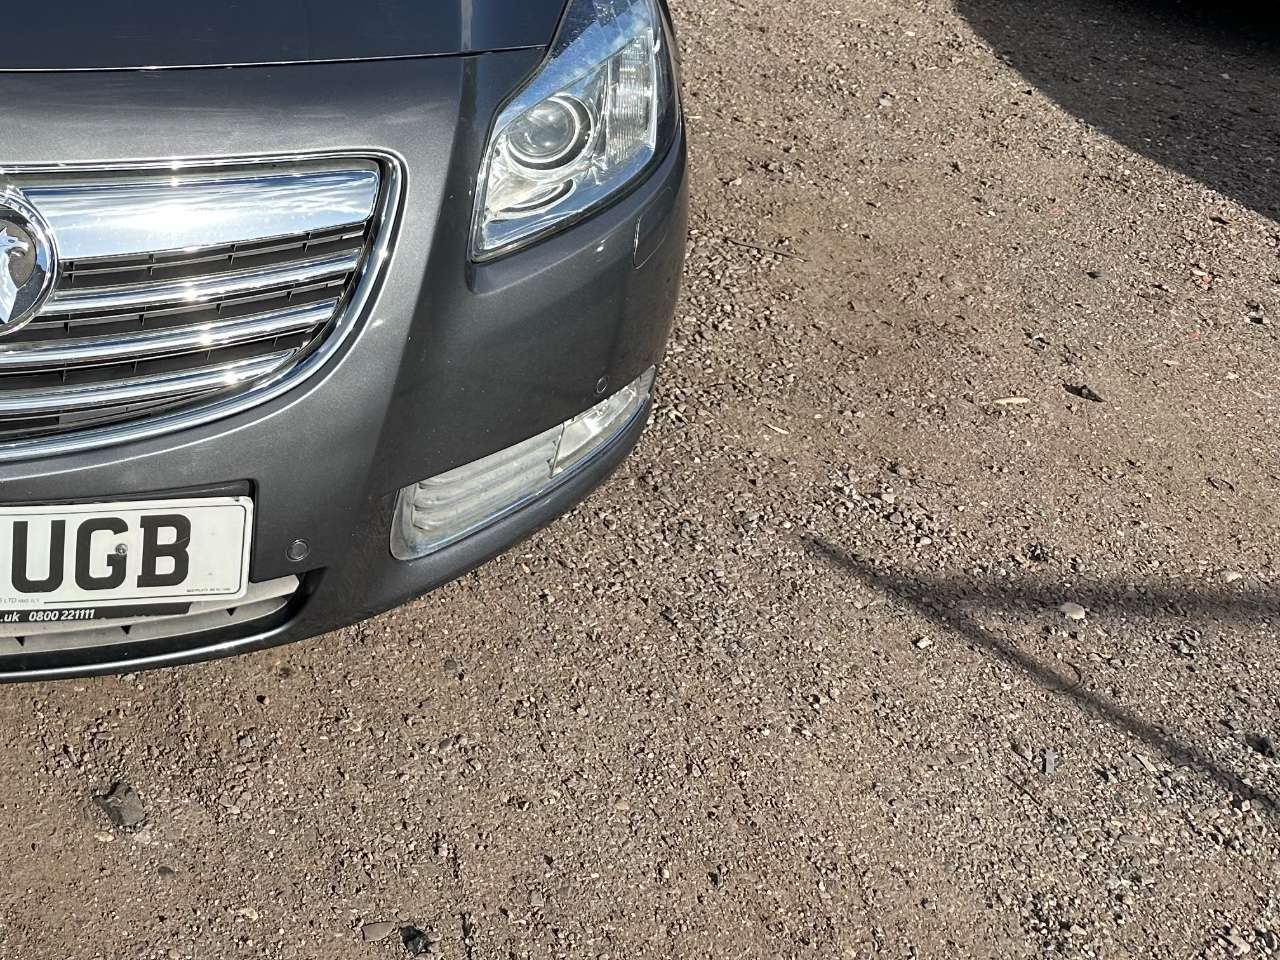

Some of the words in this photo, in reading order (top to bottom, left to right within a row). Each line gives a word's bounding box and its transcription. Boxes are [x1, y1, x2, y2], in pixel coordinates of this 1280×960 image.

[11, 513, 192, 594] UGB
[29, 610, 60, 621] 0800
[60, 608, 95, 621] 221111
